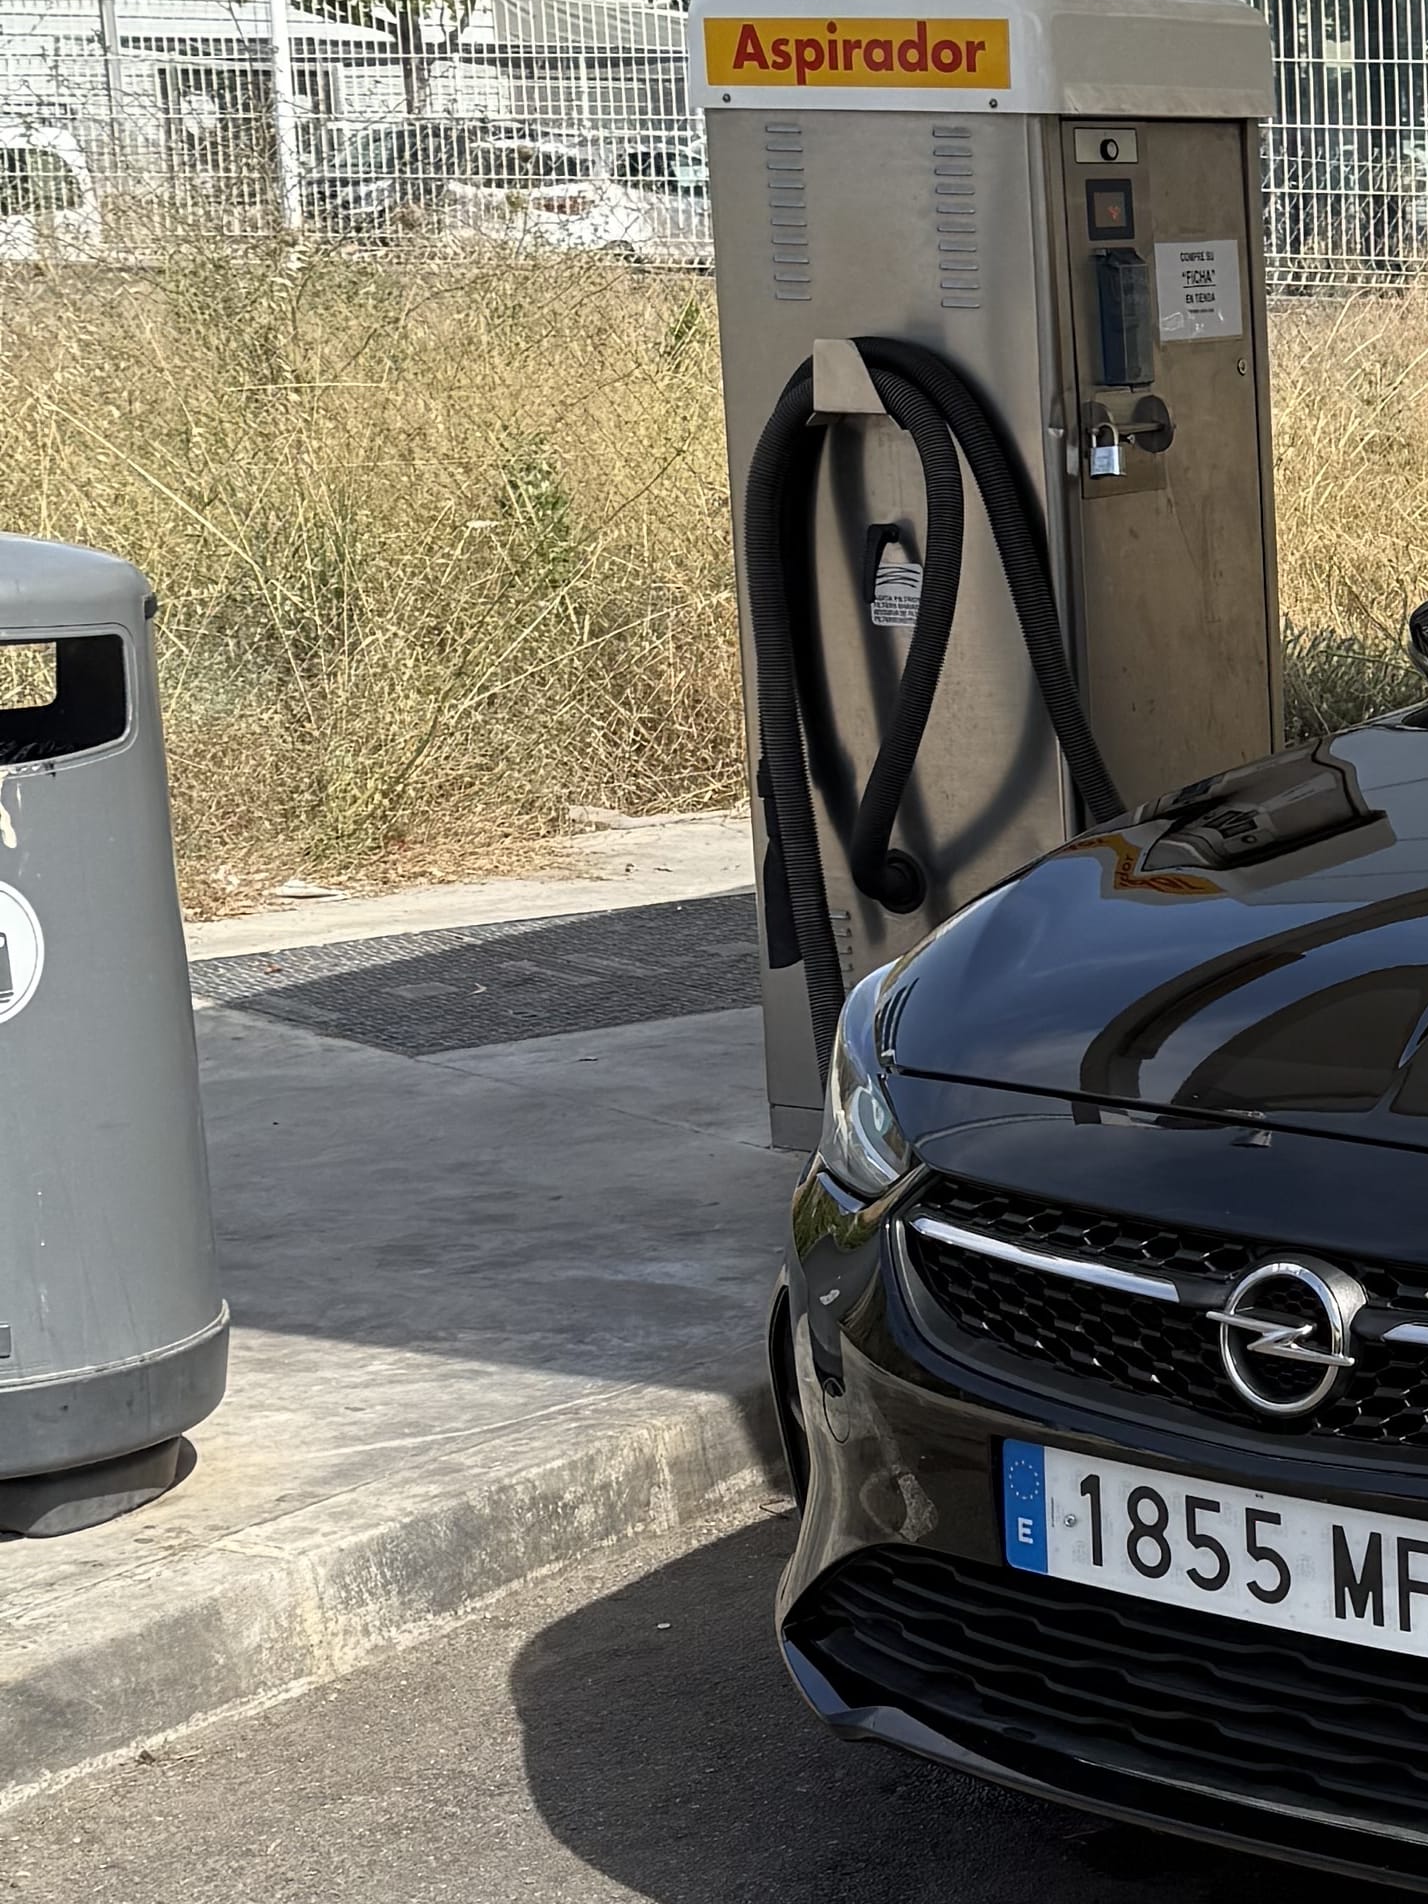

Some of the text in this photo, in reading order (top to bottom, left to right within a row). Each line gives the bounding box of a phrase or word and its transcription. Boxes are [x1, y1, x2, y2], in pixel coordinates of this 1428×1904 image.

[732, 21, 986, 86] Aspirador
[1018, 1517, 1034, 1545] E
[1080, 1473, 1291, 1605] 1855
